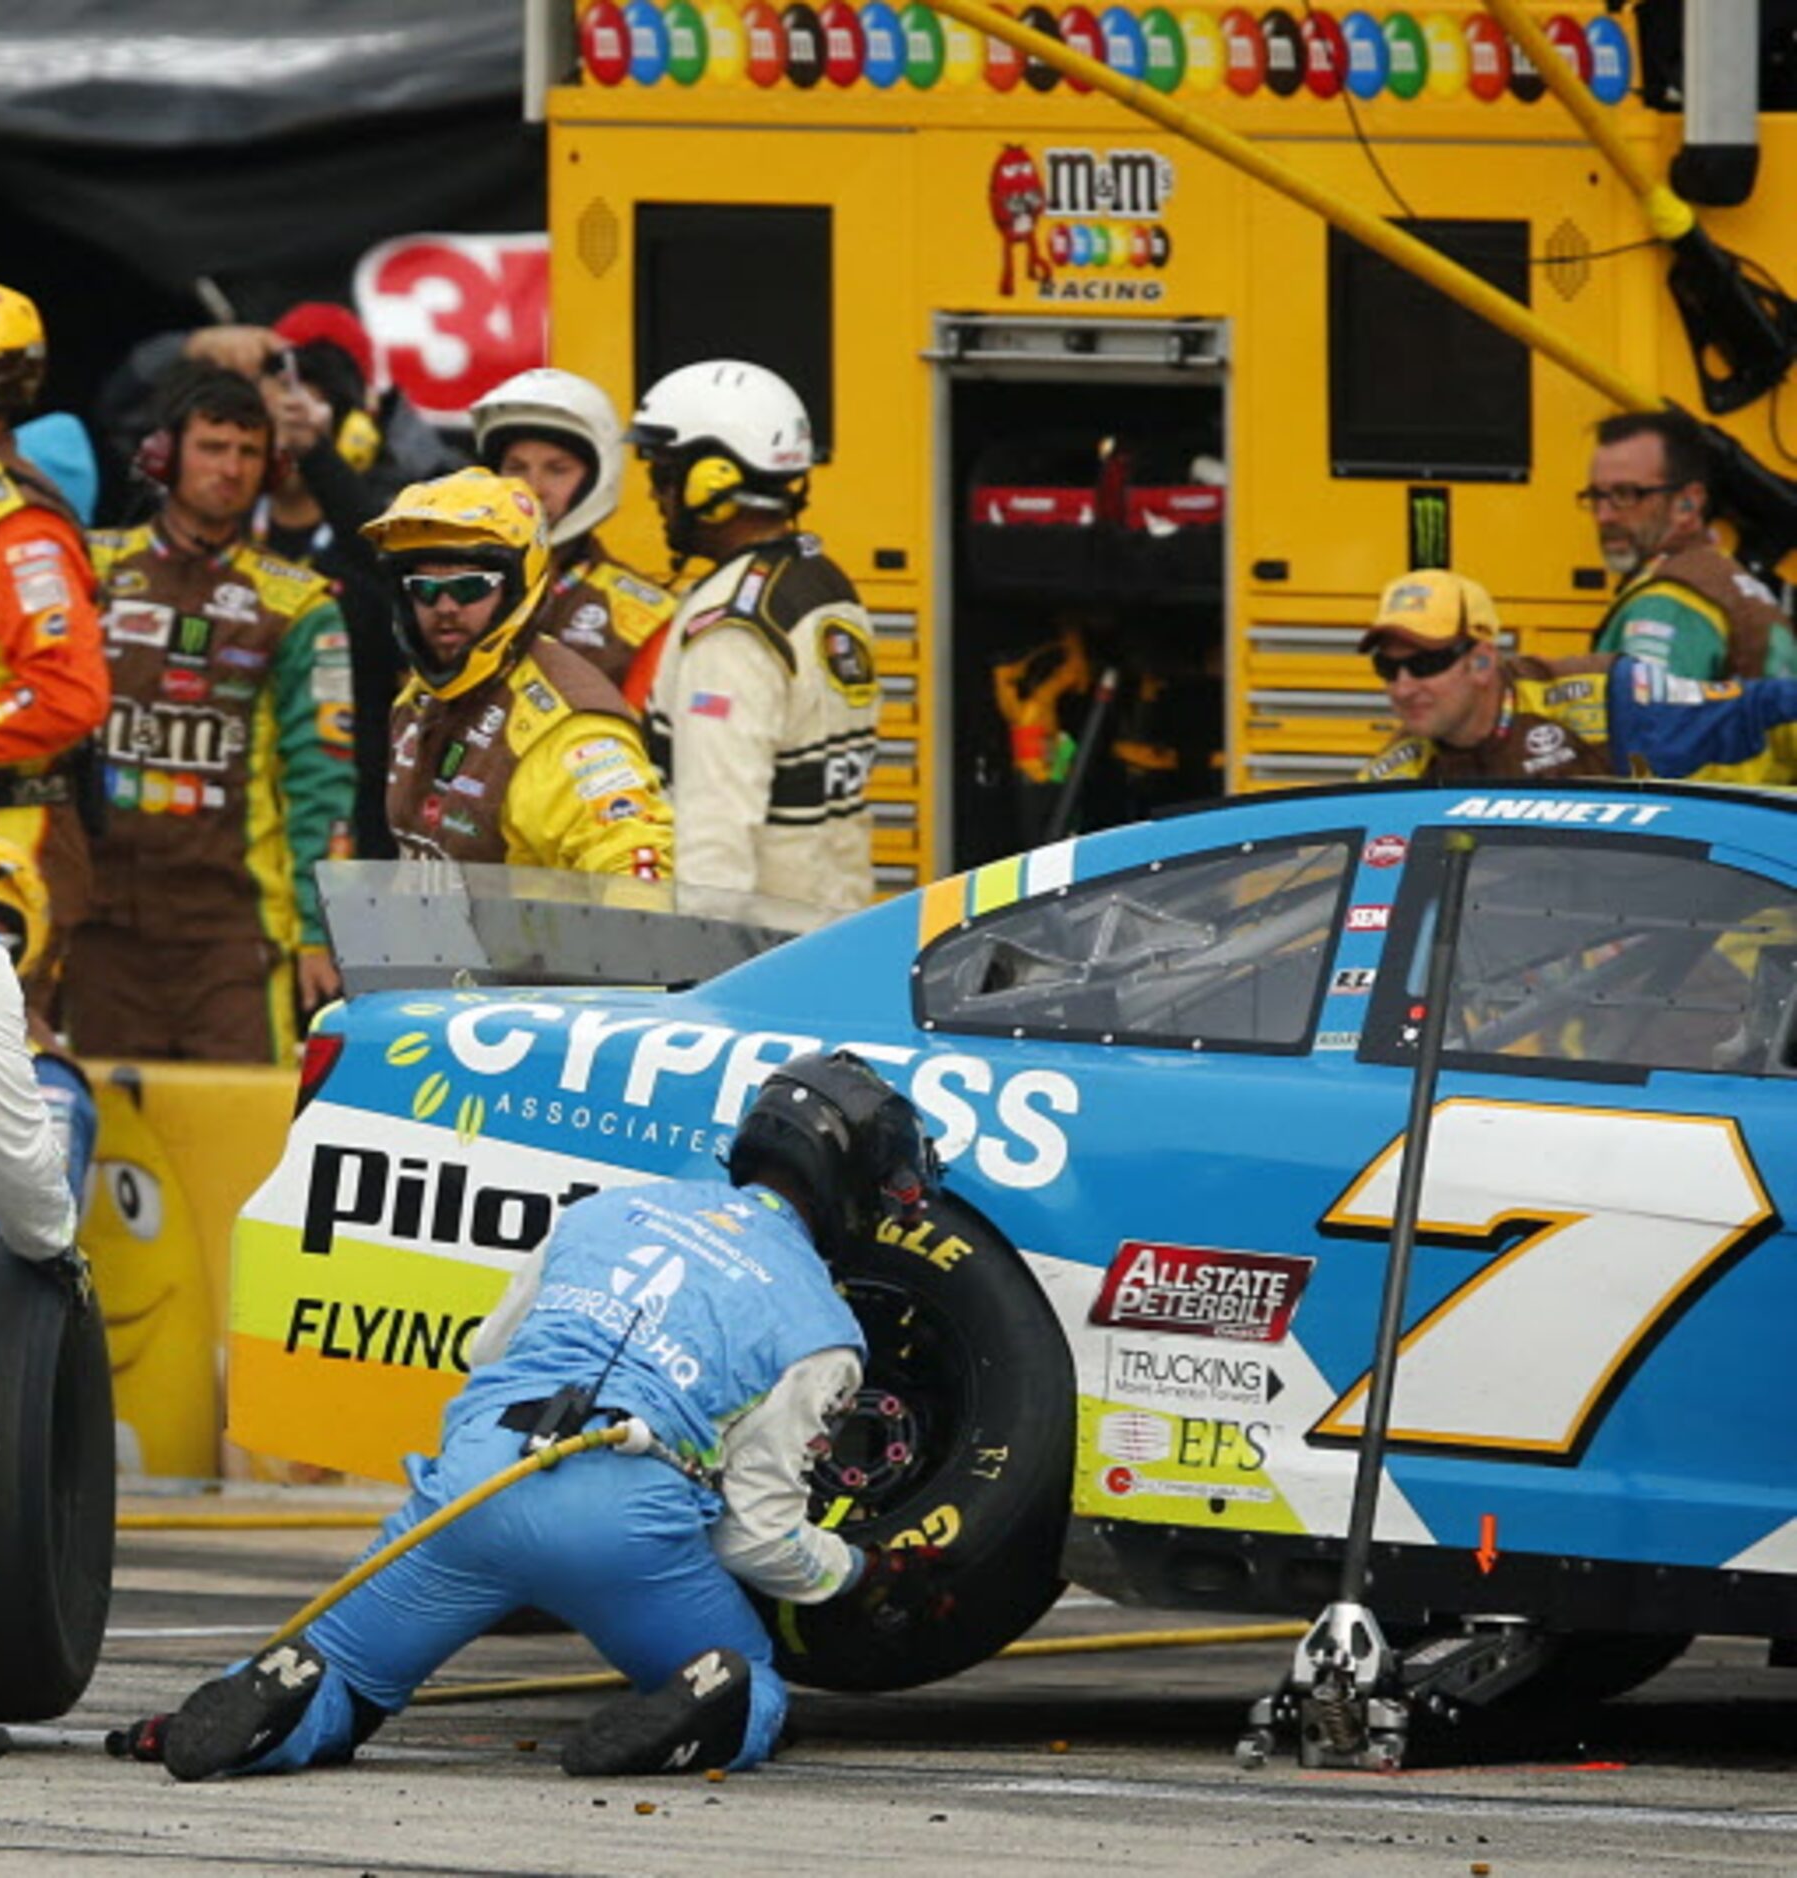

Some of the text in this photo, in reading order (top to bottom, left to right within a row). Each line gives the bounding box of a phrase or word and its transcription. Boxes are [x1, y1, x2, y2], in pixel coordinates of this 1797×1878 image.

[1039, 281, 1162, 300] RACING
[1443, 796, 1671, 825] ANNETT
[446, 1002, 1080, 1190] CYPRSS
[495, 1092, 731, 1157] ASSOCIATES
[1121, 1249, 1289, 1297] ALLSTATE
[1304, 1095, 1784, 1467] 7
[1110, 1282, 1282, 1325] PETERBILT
[1119, 1349, 1262, 1391] TRUCKING
[1178, 1416, 1271, 1472] EFS
[258, 1645, 320, 1688] N
[682, 1650, 731, 1698] N
